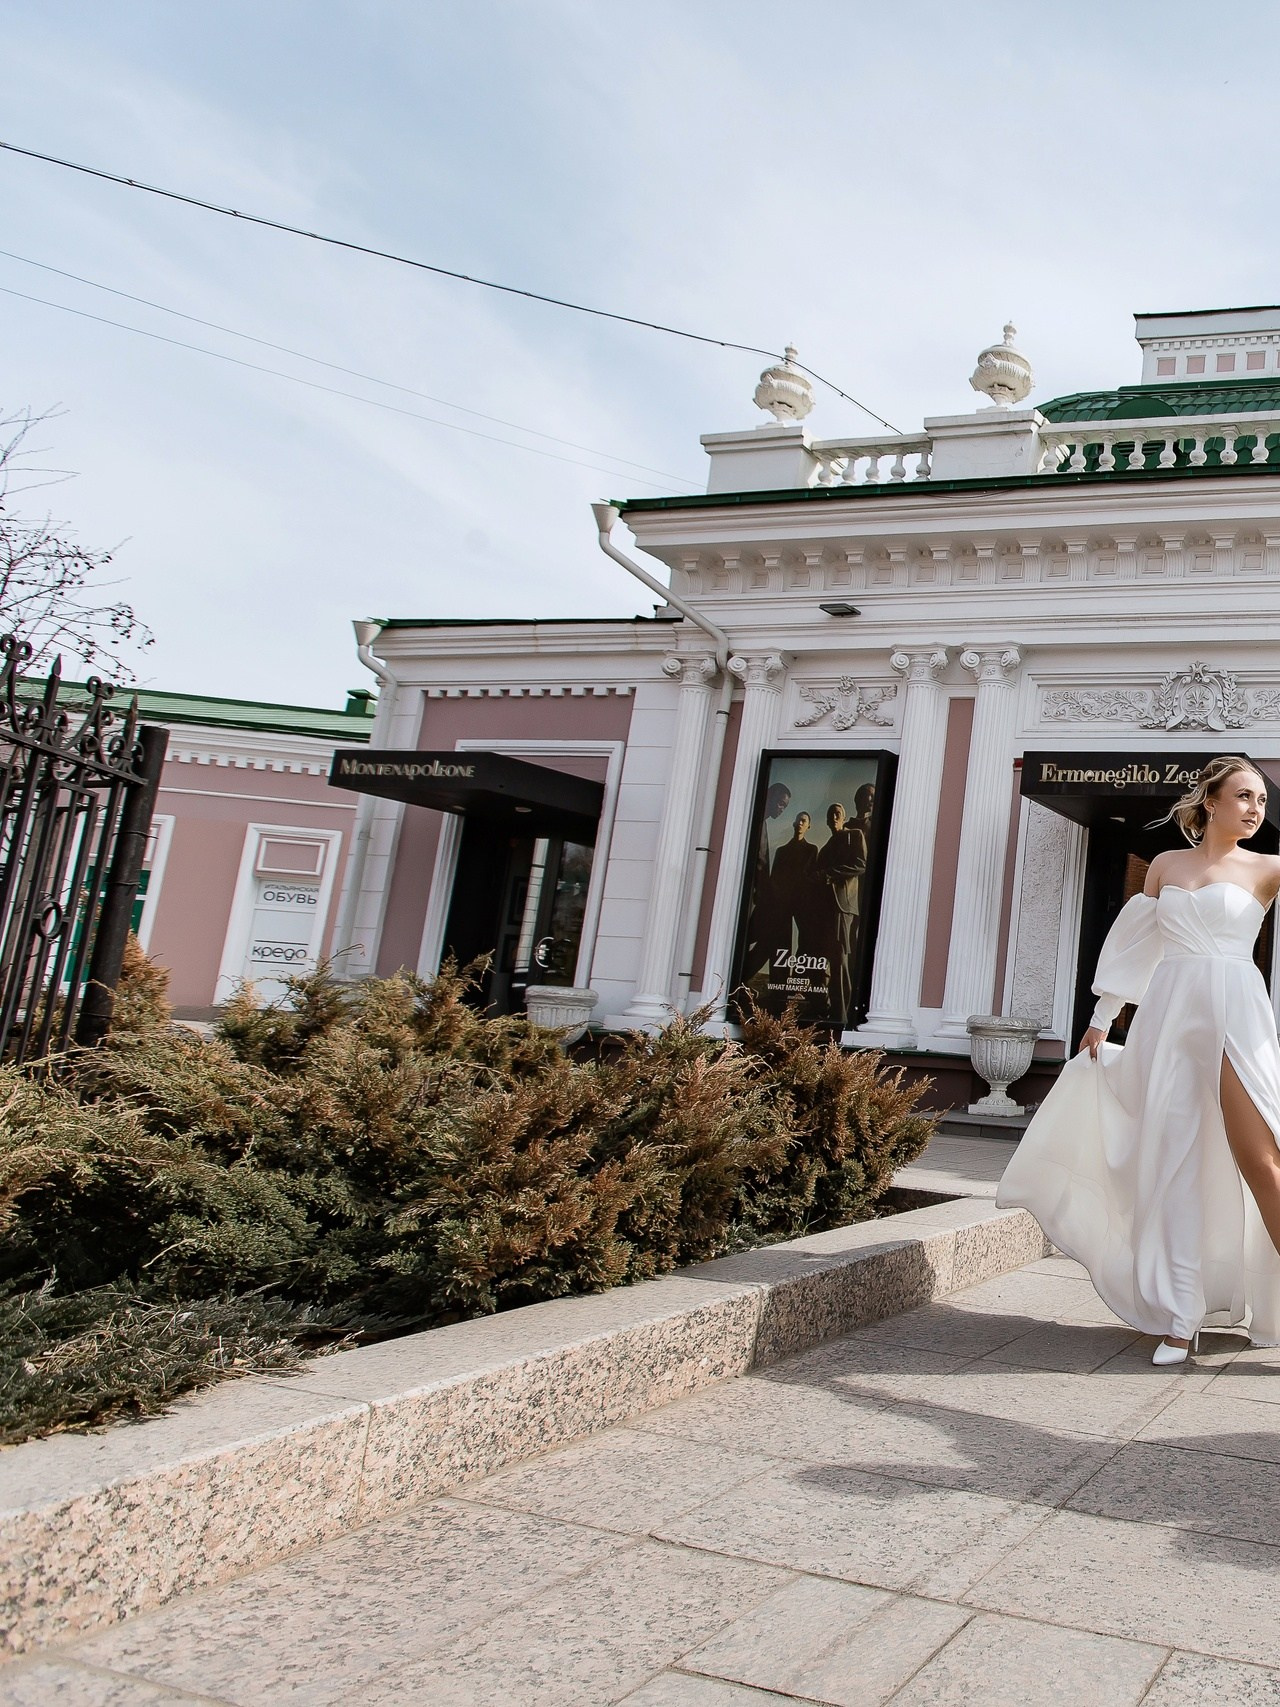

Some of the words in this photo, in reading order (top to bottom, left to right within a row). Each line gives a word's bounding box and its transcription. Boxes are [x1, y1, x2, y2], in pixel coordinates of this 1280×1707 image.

[1039, 763, 1160, 788] Ermenegildo
[1163, 764, 1201, 789] Zeg
[264, 884, 319, 892] ИТАЛЬЯНСКАЯ
[263, 891, 317, 904] ОБУВЬ
[773, 949, 828, 974] Zegna
[787, 978, 810, 986] (RESET)
